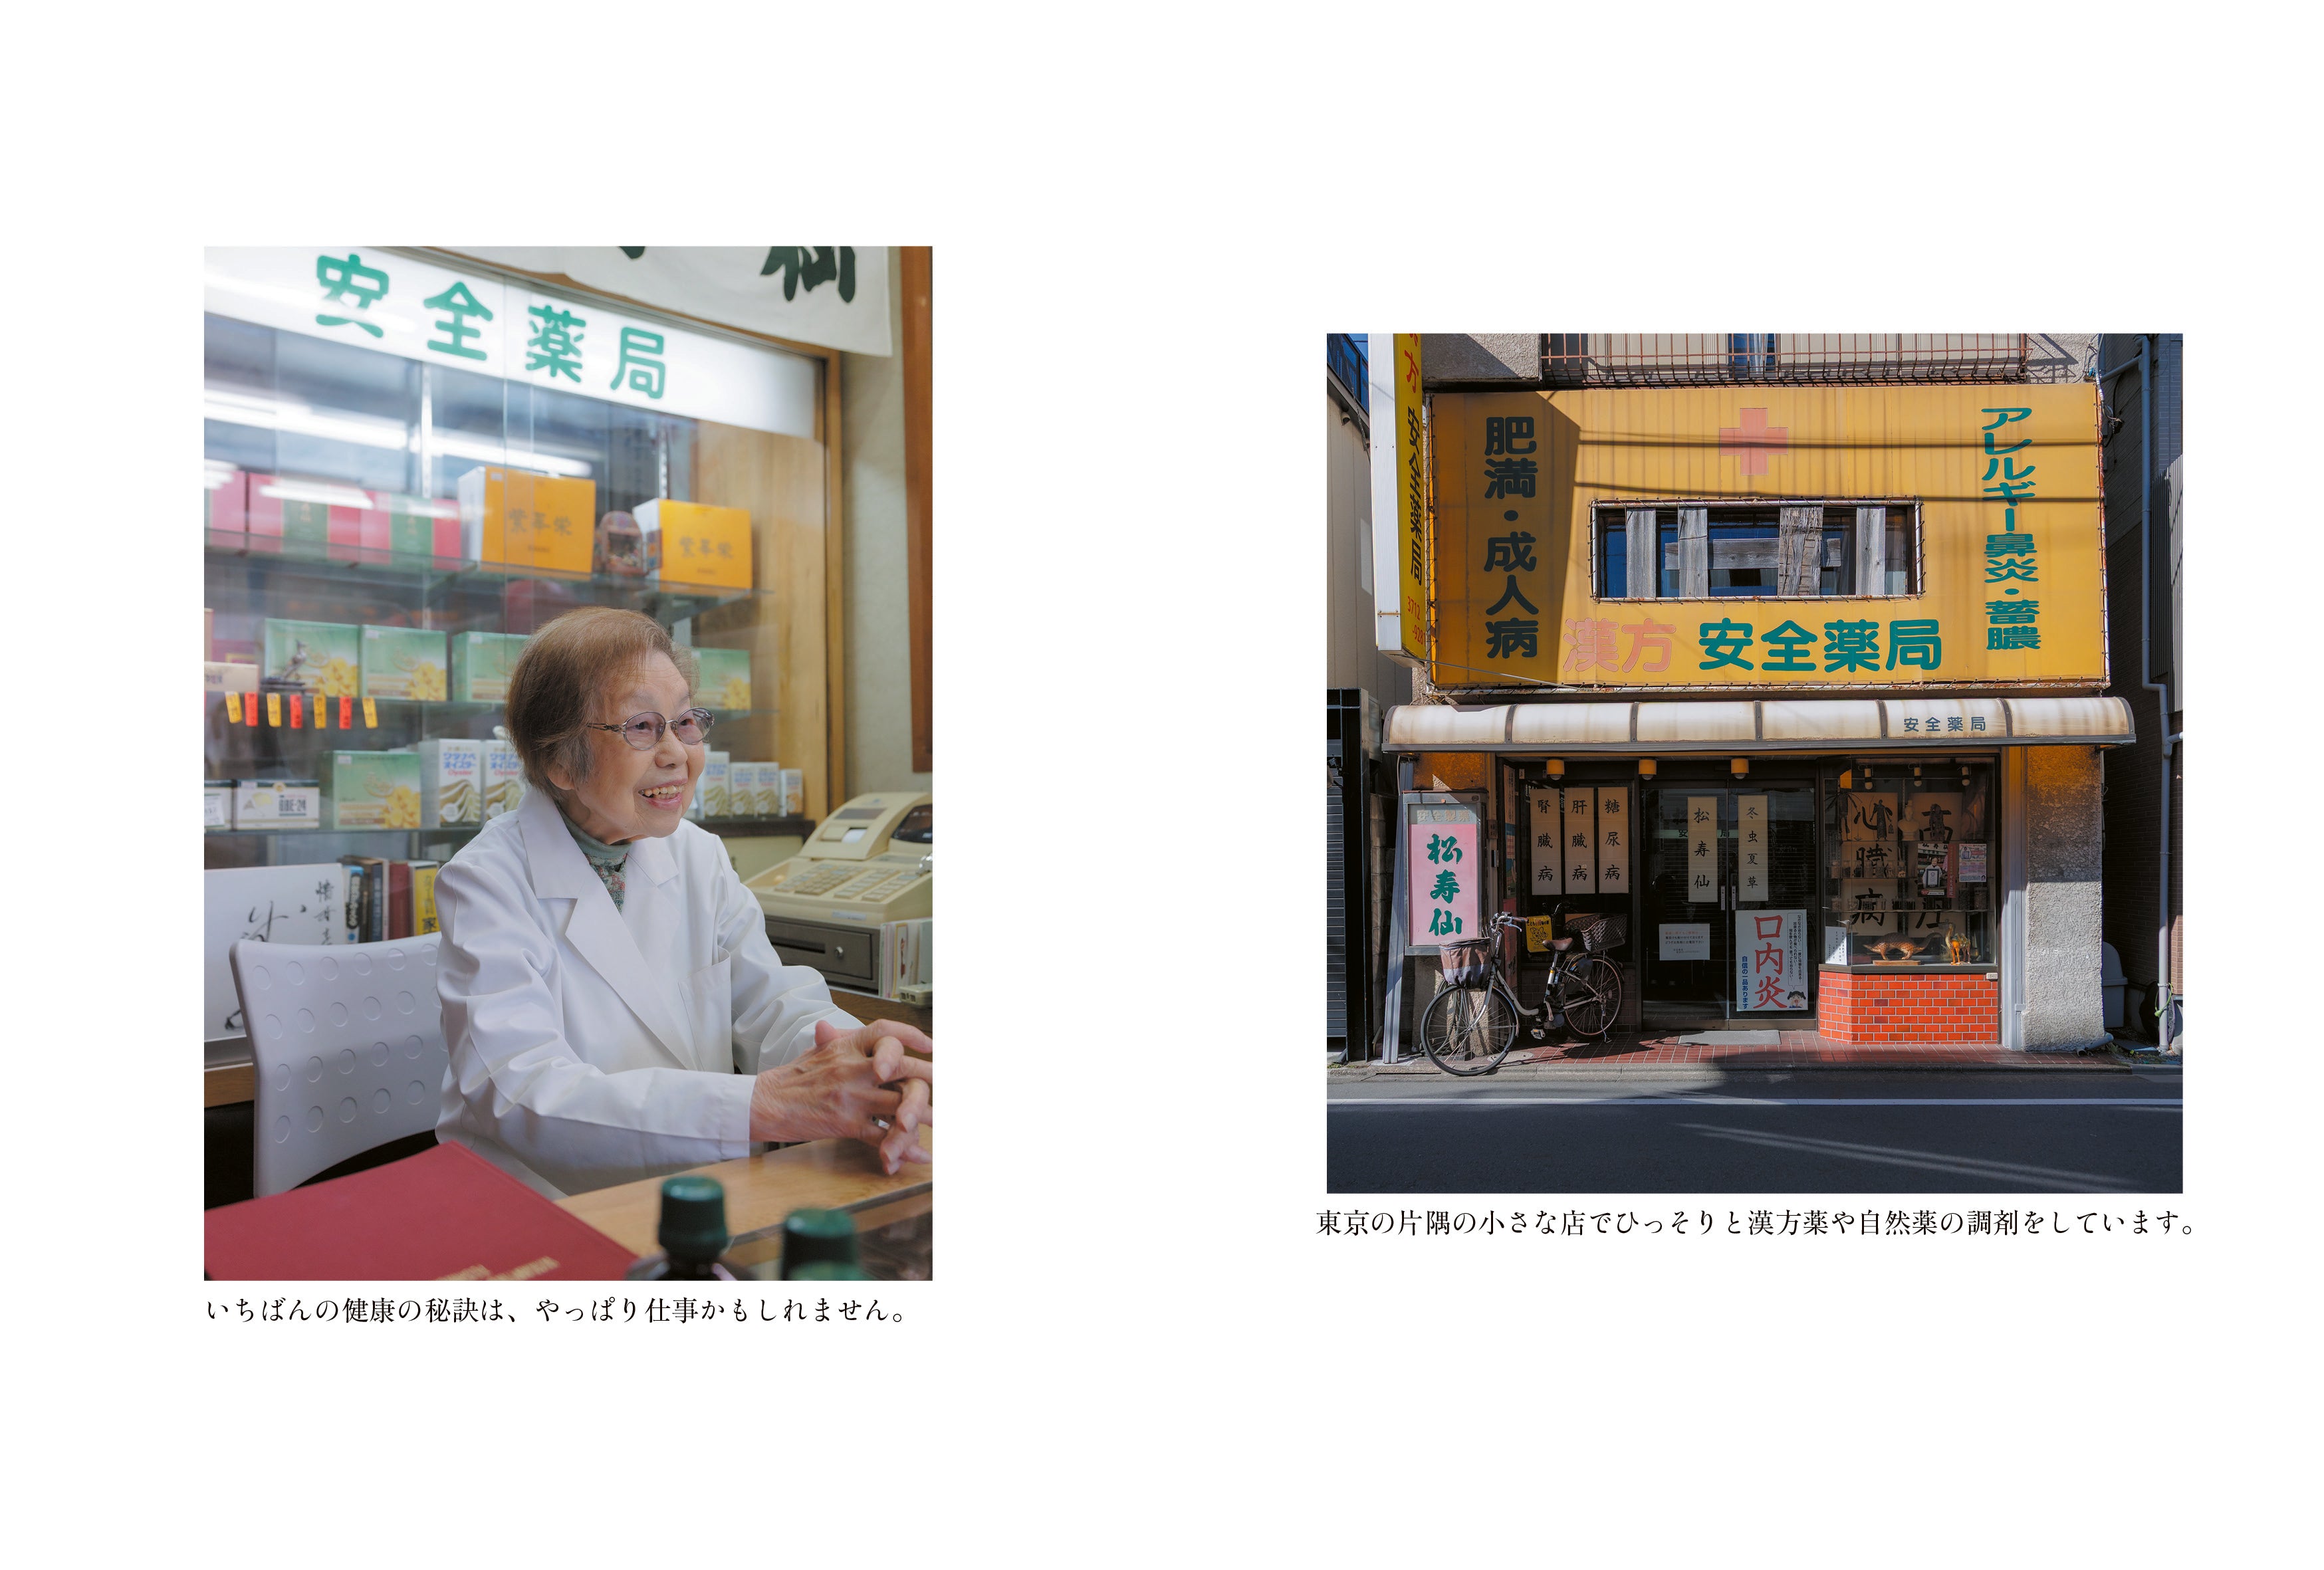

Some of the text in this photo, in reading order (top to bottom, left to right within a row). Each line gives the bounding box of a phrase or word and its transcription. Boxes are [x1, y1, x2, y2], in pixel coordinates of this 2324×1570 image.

[315, 253, 666, 400] 安全薬局
[1408, 405, 1423, 586] 安全薬局
[1981, 407, 2041, 651] アレルギー鼻炎・蓄膿
[1483, 416, 1539, 659] 肥満・成人病
[1407, 596, 1421, 621] 3712
[1563, 617, 1942, 673] 漢方 安全薬局
[1904, 717, 1986, 732] 安全薬局
[1537, 799, 1553, 882] 腎臓病
[1571, 800, 1587, 881] 肝臓病
[1604, 798, 1621, 881] 糖尿病
[1693, 807, 1710, 889] 松寿仙
[1746, 806, 1759, 889] 冬虫夏草
[1427, 834, 1463, 937] 松寿仙
[1753, 915, 1788, 1009] 口内炎
